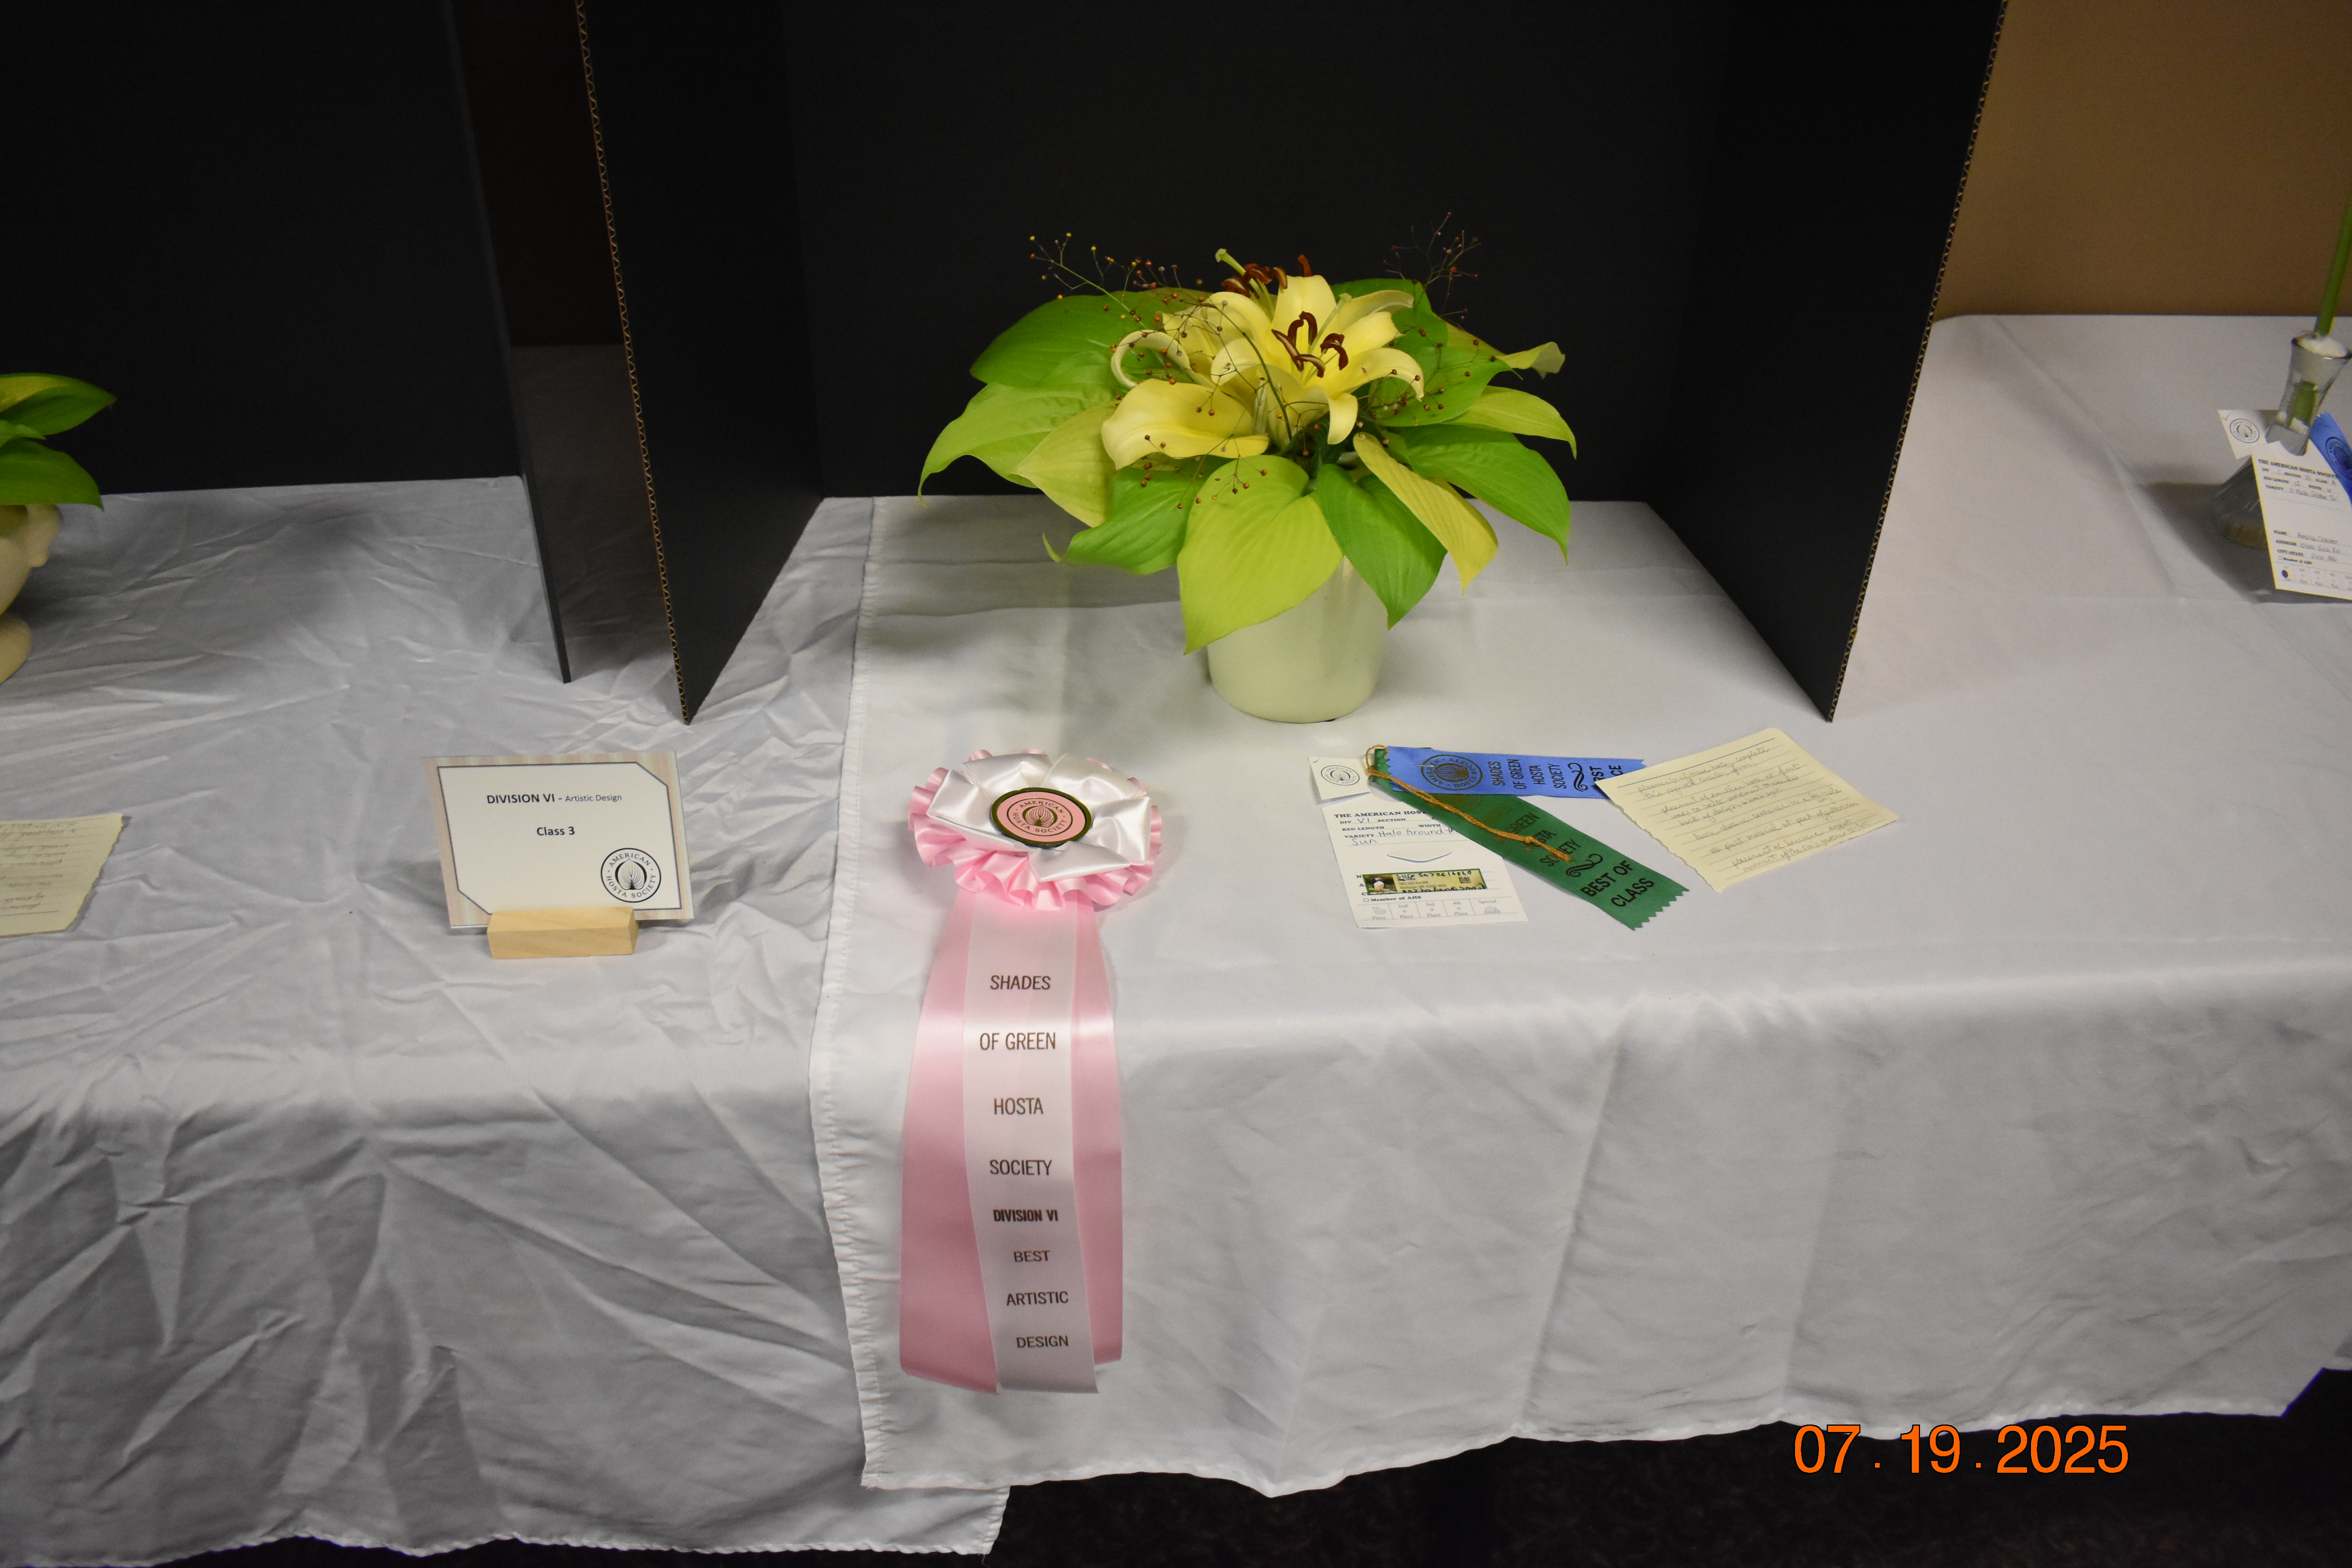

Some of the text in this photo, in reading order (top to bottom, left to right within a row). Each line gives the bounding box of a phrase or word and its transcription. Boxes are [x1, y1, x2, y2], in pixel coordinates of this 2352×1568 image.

[2270, 462, 2298, 470] AMERICAN
[1488, 761, 1506, 786] SHADES
[1507, 759, 1527, 790] OF GREEN
[1528, 764, 1546, 785] HOSTA
[1548, 763, 1567, 789] SOCIETY
[487, 794, 540, 804] DIVISION
[543, 793, 555, 802] VI
[595, 794, 622, 803] Design
[1019, 800, 1065, 814] AMERICAN
[1013, 812, 1067, 833] HOSTA SOCIETY
[537, 826, 575, 836] Class 3
[1352, 838, 1377, 846] Sun
[609, 852, 651, 868] AMERICAN
[606, 874, 657, 898] HOSTA SOCIETY
[1580, 860, 1633, 897] BEST OF
[1611, 878, 1655, 907] CLASS
[990, 975, 1051, 990] SHADES
[980, 1032, 1056, 1051] OF GREEN
[994, 1097, 1044, 1115] HOSTA
[989, 1159, 1053, 1176] SOCIETY
[993, 1209, 1059, 1222] DIVISION VI
[1013, 1250, 1050, 1263] BEST
[1006, 1290, 1069, 1306] ARTISTIC
[1016, 1335, 1069, 1348] DESIGN
